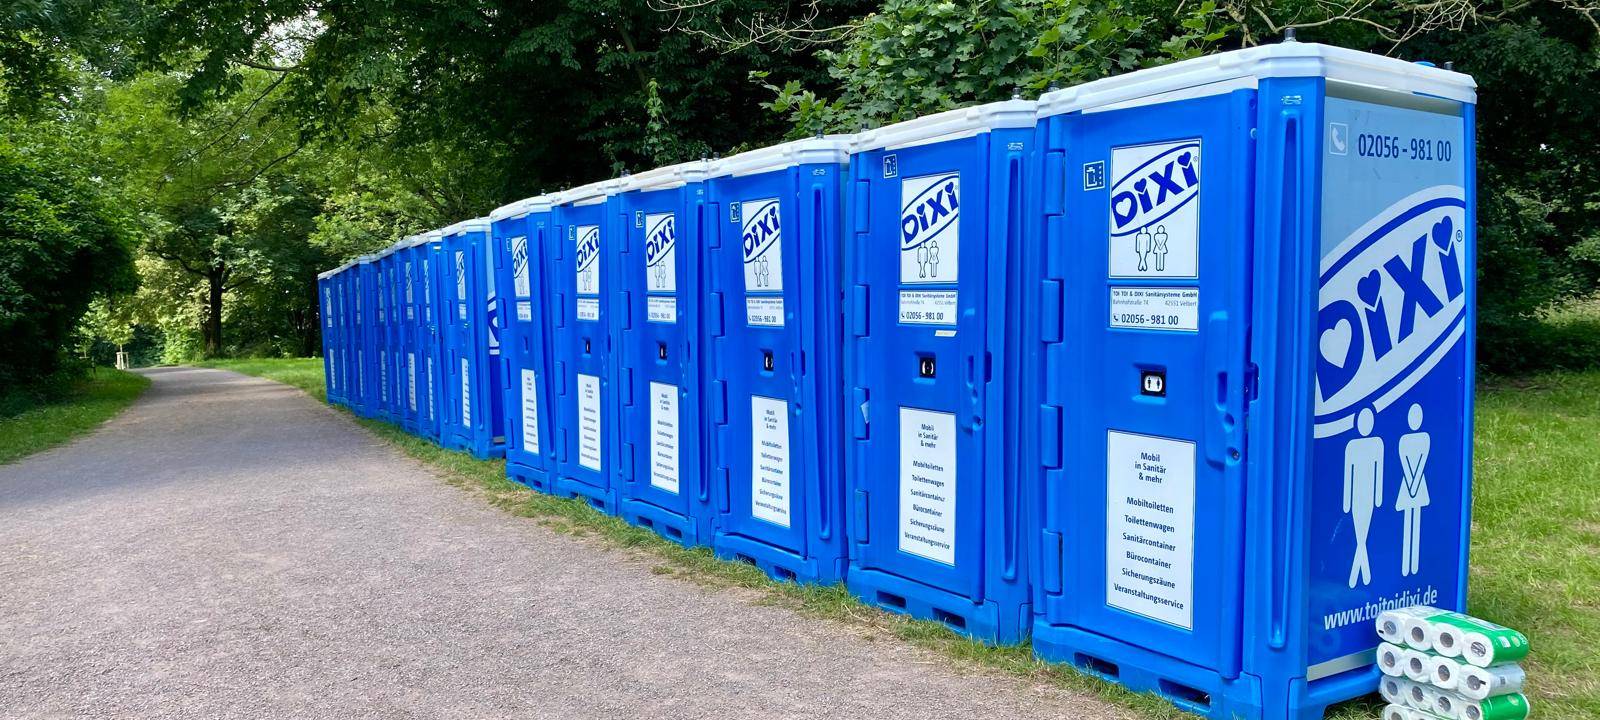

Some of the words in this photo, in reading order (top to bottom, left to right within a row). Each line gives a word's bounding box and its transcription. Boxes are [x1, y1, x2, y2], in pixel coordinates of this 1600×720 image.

[1358, 134, 1399, 158] 02056
[1410, 138, 1432, 160] 981
[1437, 140, 1452, 162] 00
[1121, 313, 1145, 324] 02056
[1150, 315, 1166, 324] 981
[1168, 315, 1179, 325] 00
[1140, 452, 1160, 462] Mobil
[1135, 460, 1141, 469] in
[1142, 462, 1166, 474] Sanitär
[1138, 472, 1144, 480] &
[1145, 475, 1162, 483] mehr
[1126, 496, 1174, 514] Mobiltoiletten
[1124, 514, 1175, 533] Toilettenwagen
[1122, 532, 1176, 551] Sanitärcontainer
[1126, 551, 1172, 569] Bürocontainer
[1122, 567, 1175, 588] Sicherungszäune
[1114, 583, 1184, 610] Veranstaltungsservice
